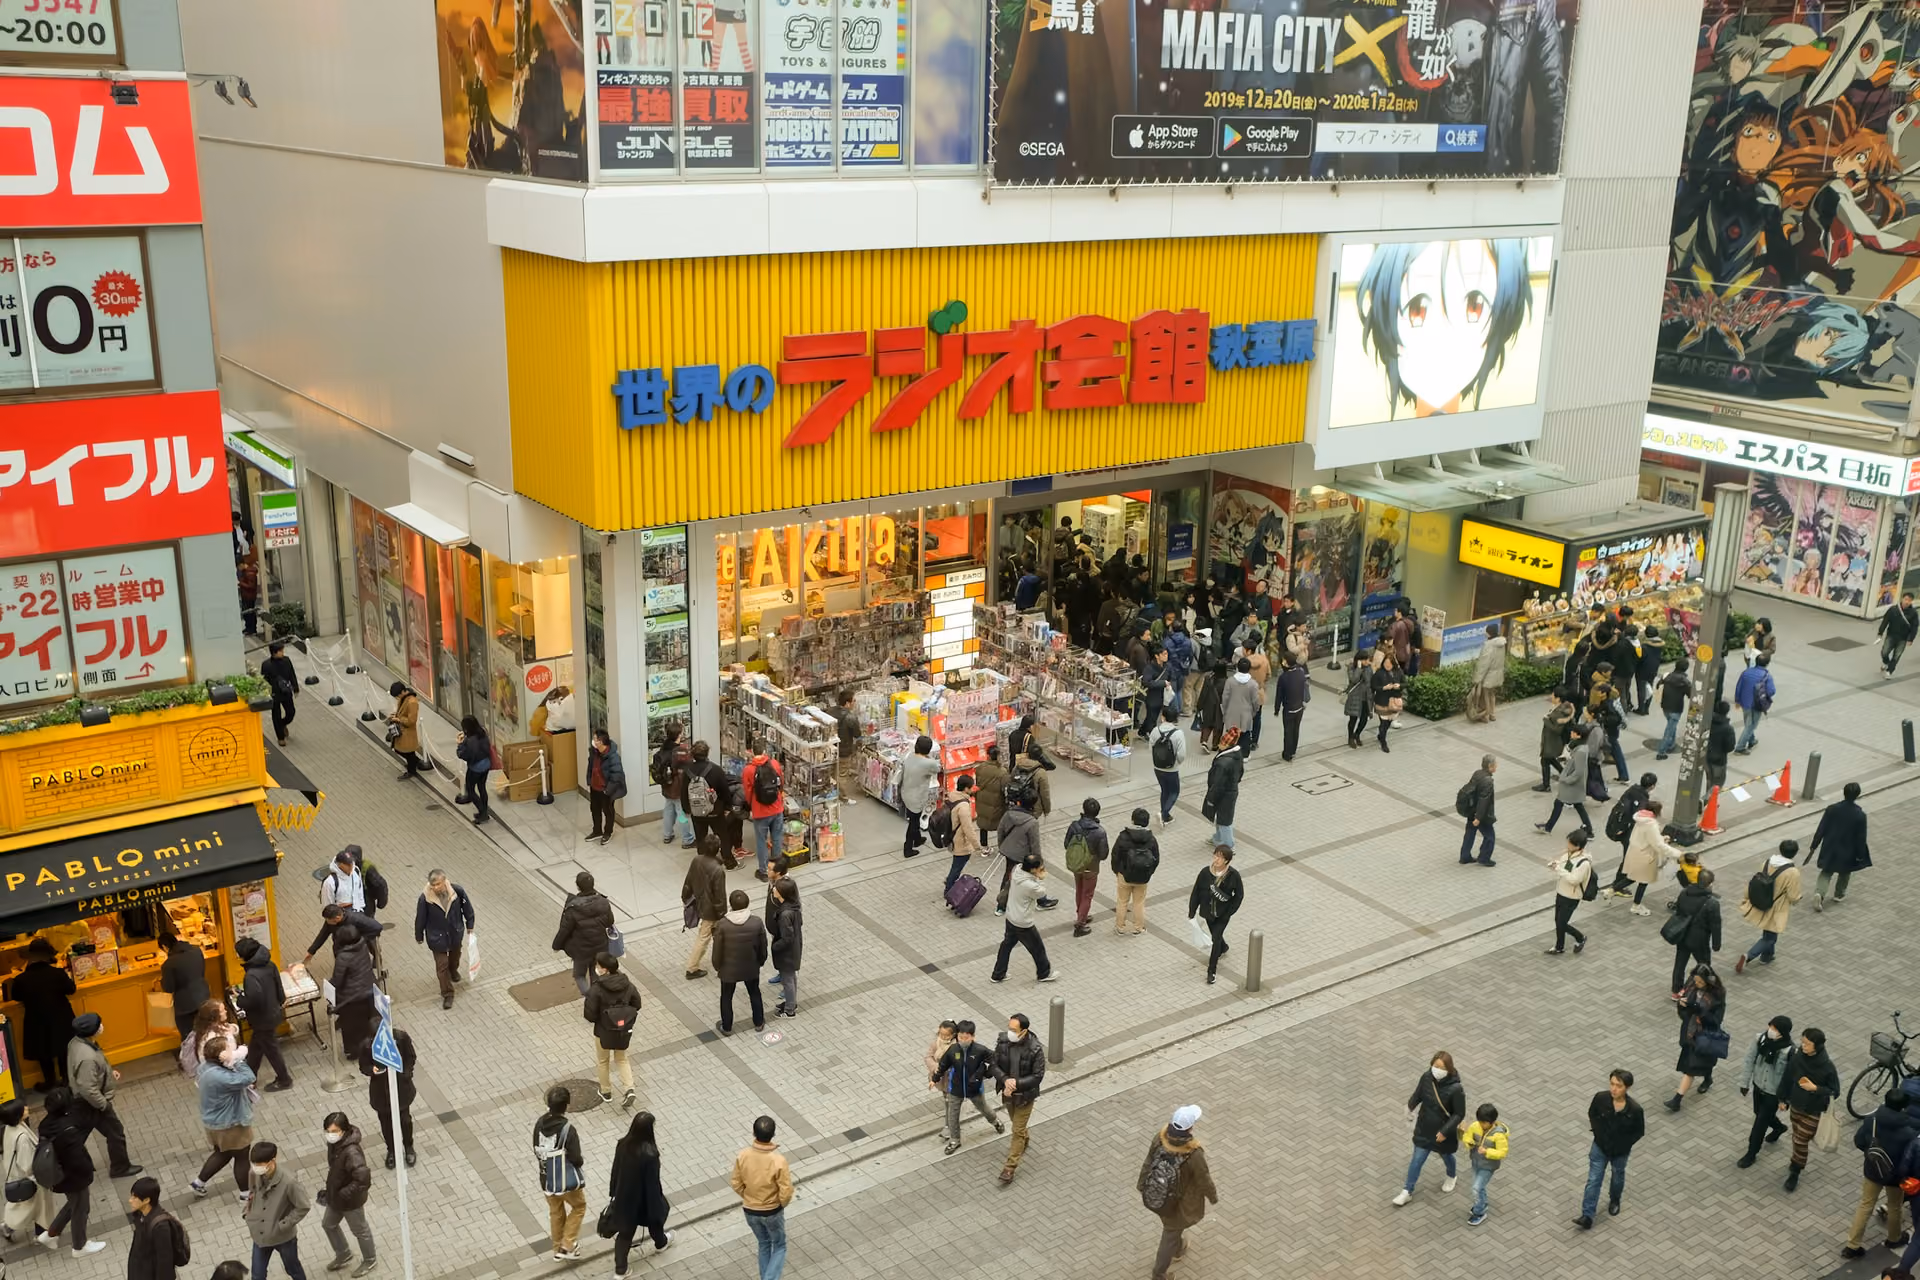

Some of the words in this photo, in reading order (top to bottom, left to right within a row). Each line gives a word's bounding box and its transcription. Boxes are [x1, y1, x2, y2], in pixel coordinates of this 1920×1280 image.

[1081, 0, 1095, 35] 会長
[1161, 9, 1263, 71] MAFIA
[1272, 15, 1343, 74] CITY
[780, 57, 813, 67] TOYS
[819, 58, 827, 67] &
[842, 58, 887, 68] IGURES
[1148, 125, 1169, 138] App
[1171, 124, 1198, 138] Store
[1246, 125, 1279, 142] Google
[1280, 127, 1299, 142] Play
[1335, 129, 1422, 145] マフィア・シティ
[1456, 129, 1479, 146] 検索
[1148, 139, 1195, 150] からダウンロード
[1246, 142, 1288, 153] で手に入れよう
[611, 364, 775, 430] 世界の
[777, 300, 1210, 449] ラジオ会館
[1210, 319, 1317, 371] 秋葉原
[1735, 439, 1829, 475] エスパス
[1839, 457, 1893, 488] 日拓
[1507, 549, 1554, 569] ライオン
[197, 743, 230, 760] mini
[32, 765, 104, 790] PABLO
[111, 758, 147, 775] mini
[5, 849, 143, 892] PABLO
[154, 831, 223, 861] mini
[46, 886, 76, 899] THE
[88, 870, 151, 889] CHEESE
[162, 859, 200, 873] TART
[78, 888, 140, 912] PABLO
[144, 881, 177, 898] mini
